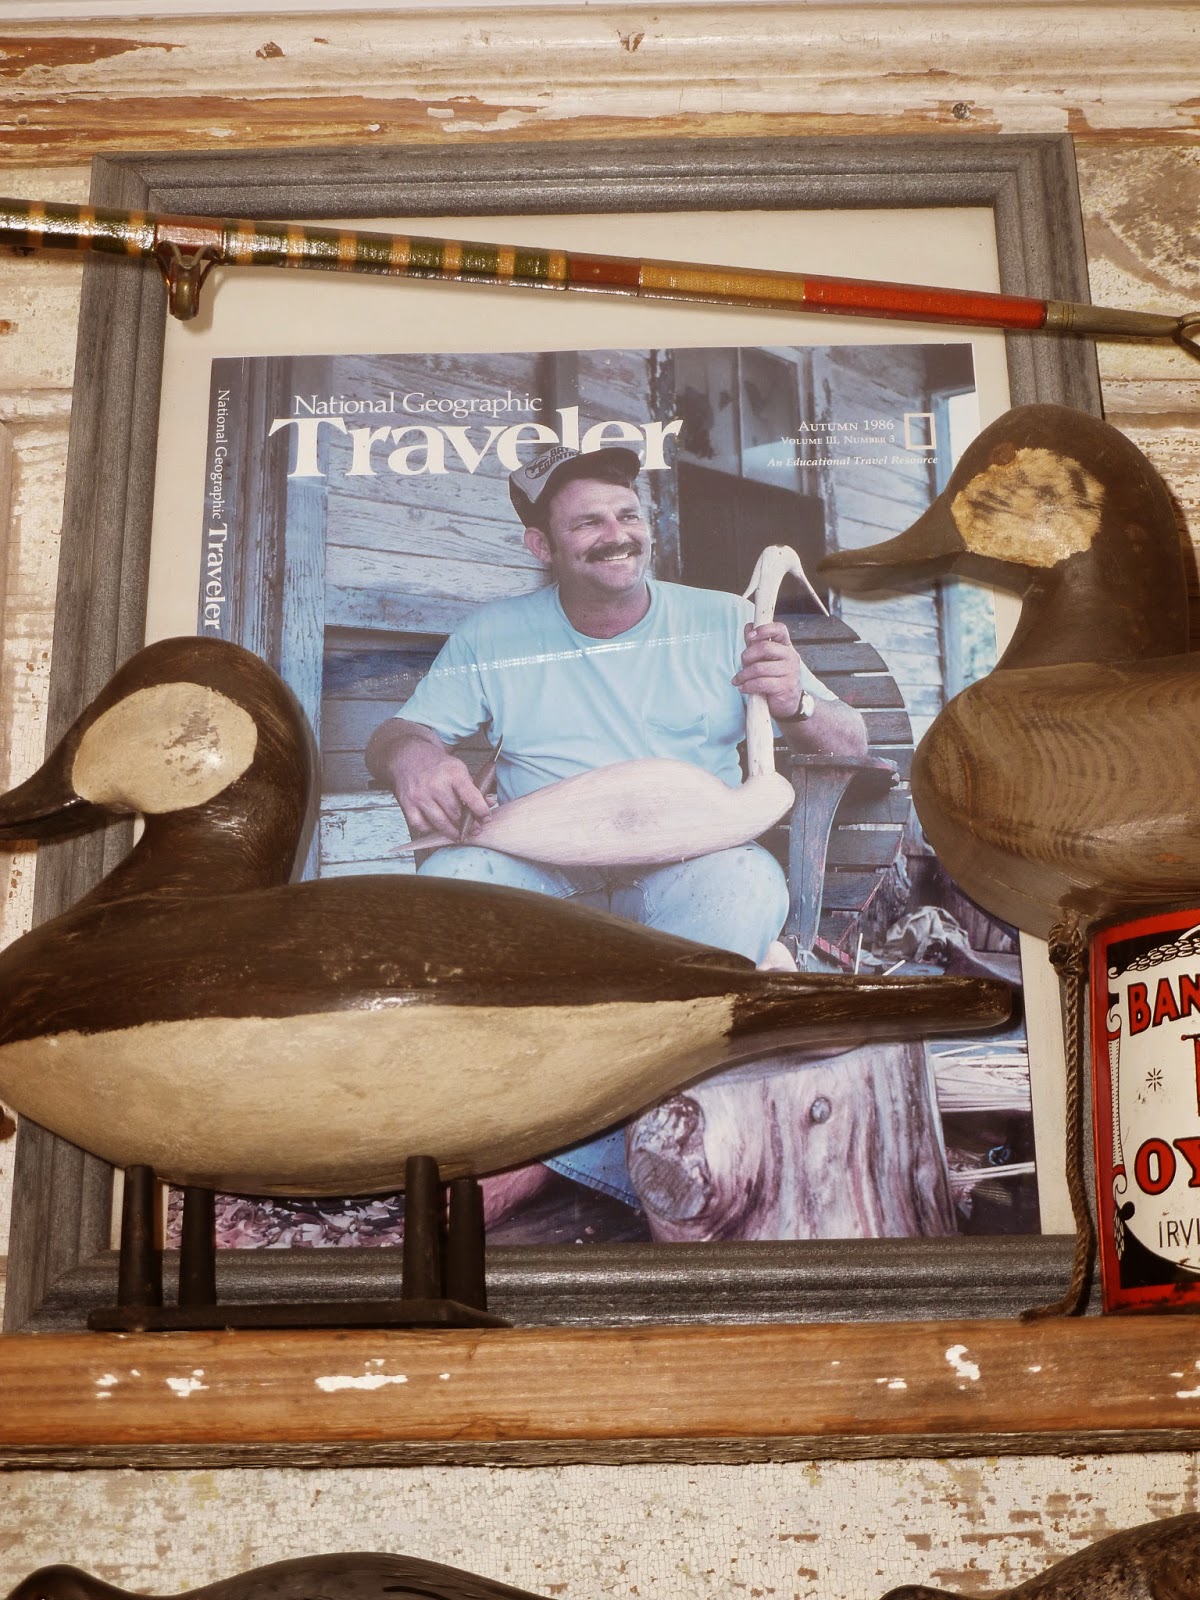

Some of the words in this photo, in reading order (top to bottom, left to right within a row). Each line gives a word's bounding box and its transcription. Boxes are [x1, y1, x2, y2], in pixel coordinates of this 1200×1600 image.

[215, 389, 231, 443] National
[294, 393, 395, 415] National
[402, 392, 543, 419] Geographic
[798, 421, 859, 432] AUTUMN
[863, 419, 895, 431] 1986
[268, 406, 684, 476] Traveler
[781, 436, 823, 445] VOLUME
[843, 435, 886, 444] NUMBER
[888, 434, 896, 443] 3
[539, 451, 578, 471] COUNTR
[767, 458, 782, 467] An
[786, 456, 850, 467] Educational
[854, 456, 888, 465] Travel
[891, 455, 938, 465] Resource
[210, 446, 228, 519] Geographic
[204, 523, 228, 630] Traveler
